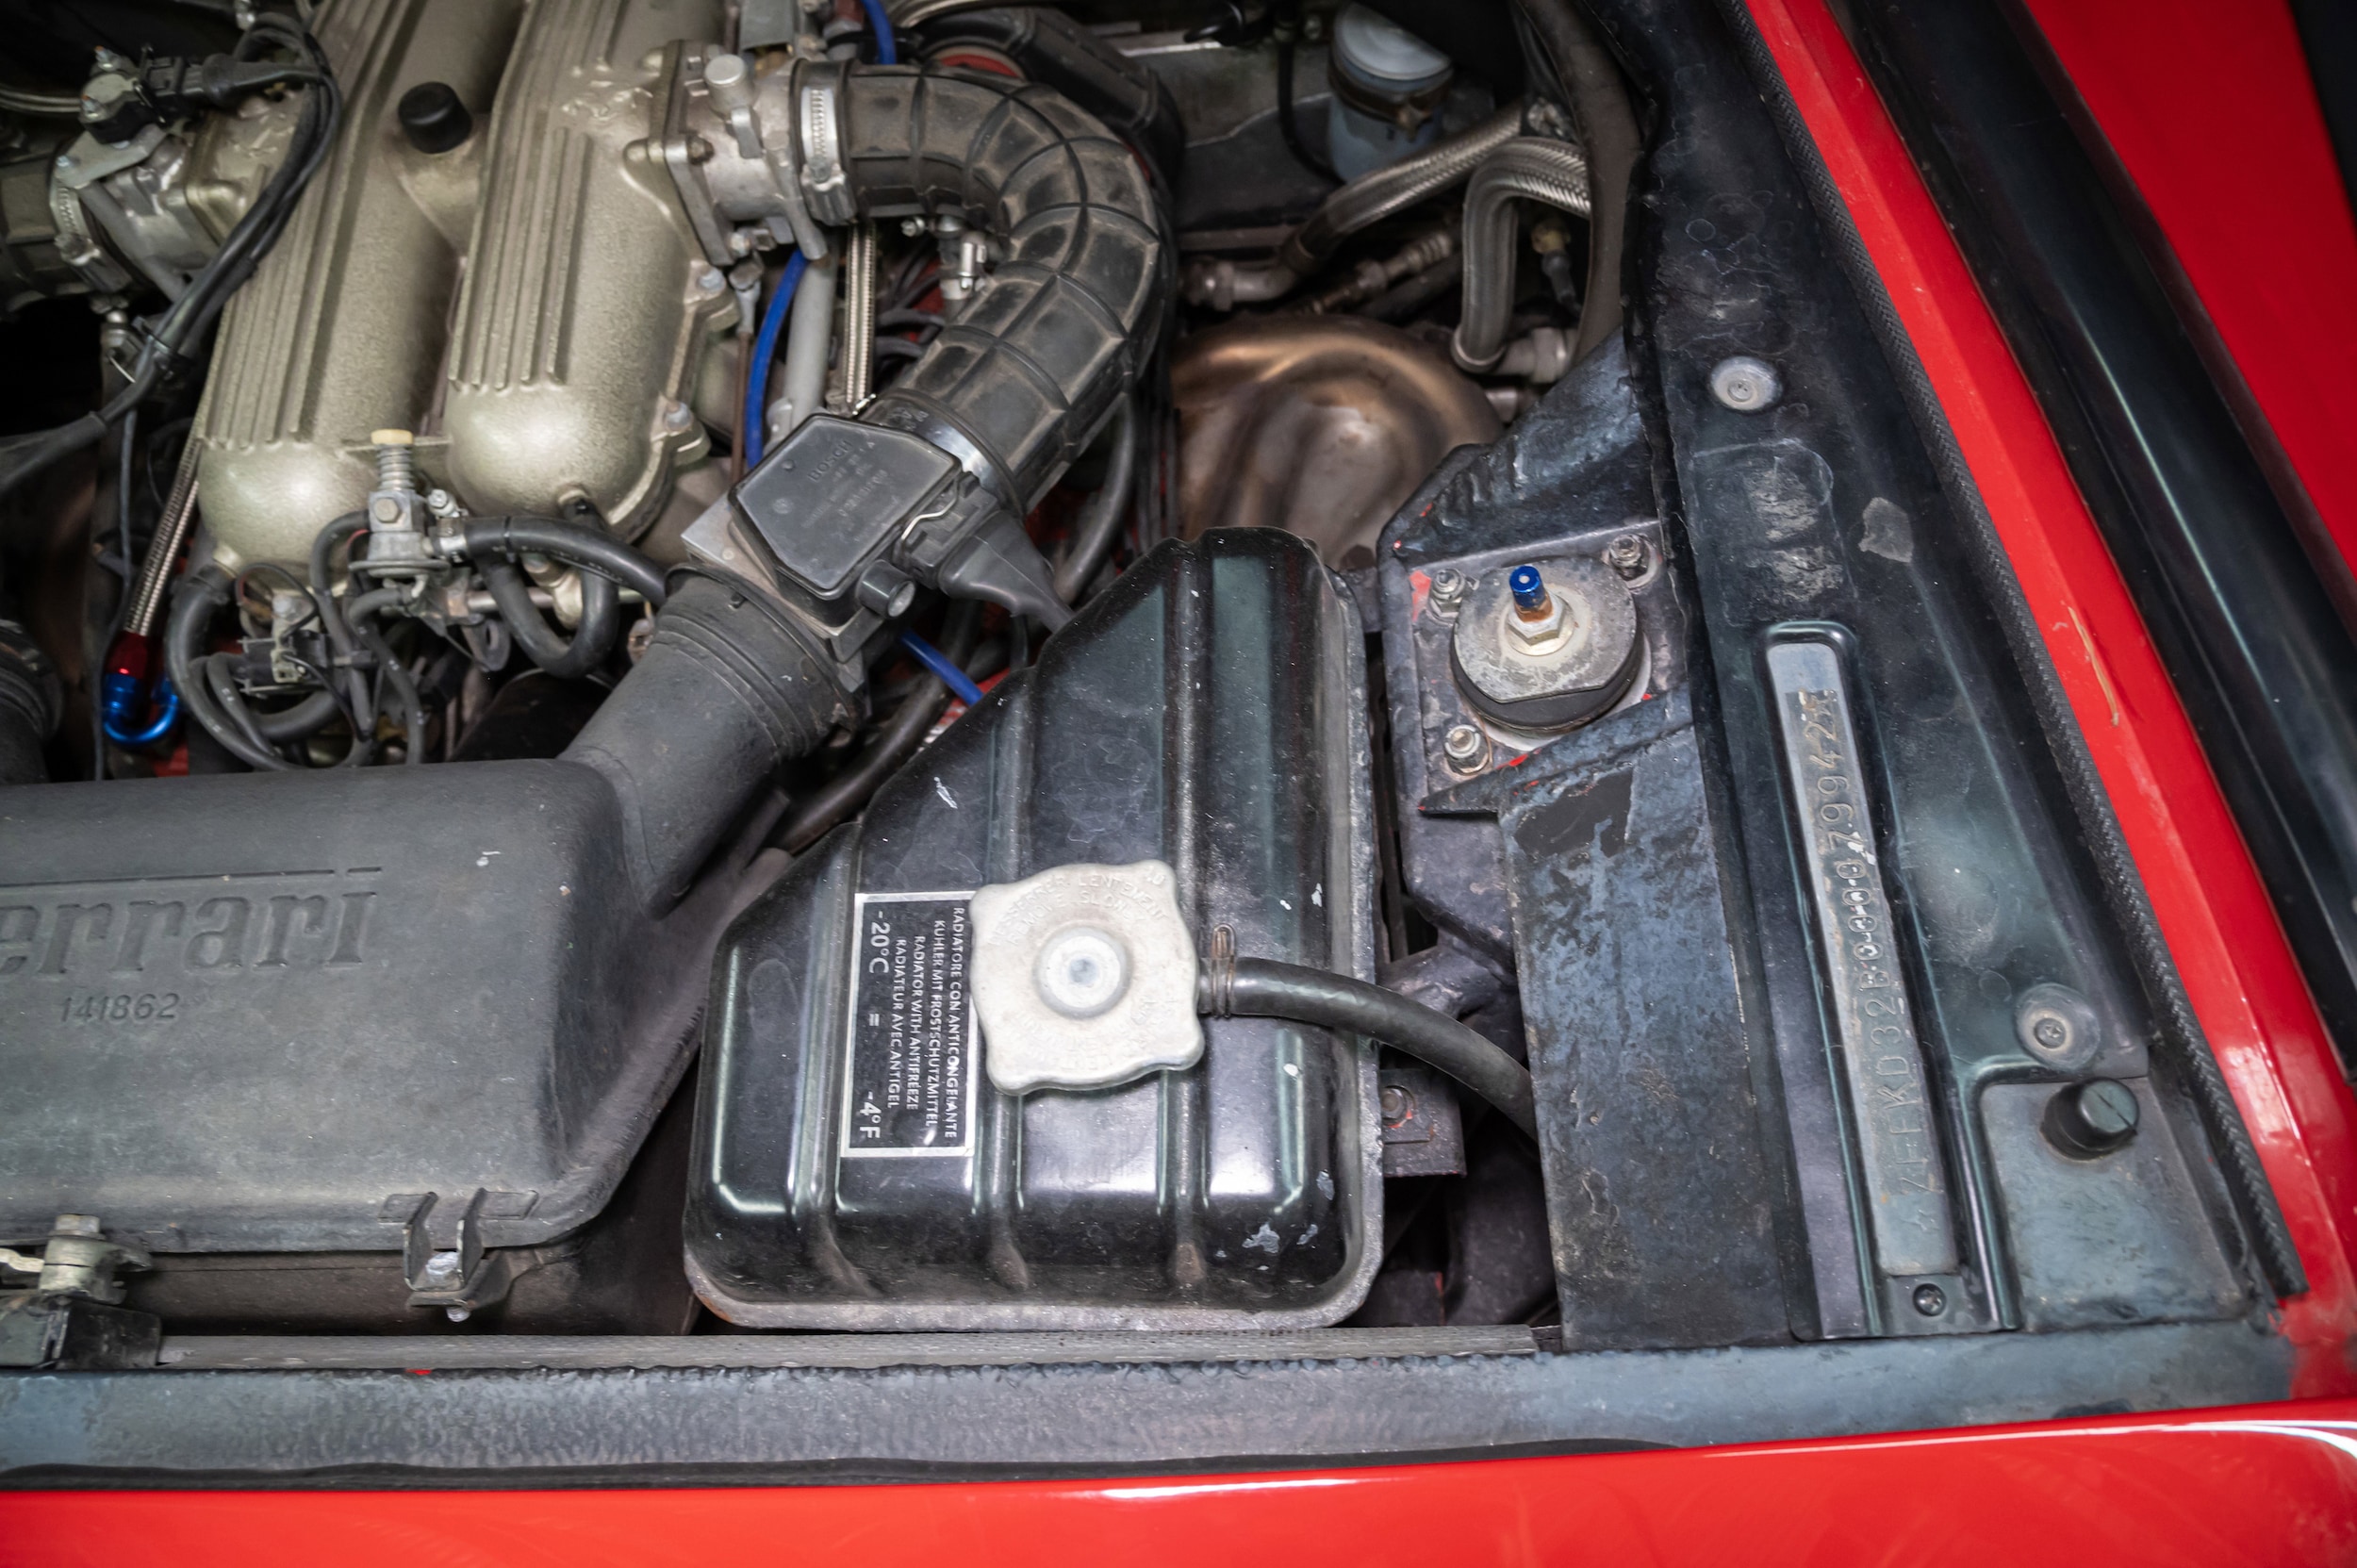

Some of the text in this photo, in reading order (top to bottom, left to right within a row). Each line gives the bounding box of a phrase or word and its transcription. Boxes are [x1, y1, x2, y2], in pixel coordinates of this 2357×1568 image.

[807, 439, 852, 482] BOSCH
[0, 867, 381, 976] errari
[1078, 874, 1168, 921] LENTEMENT
[59, 992, 181, 1022] 141862
[887, 939, 907, 1109] RADIATEUR AVEC ANTIGEL
[906, 935, 926, 1110] RADIATOR WITH ANTIFREEZE
[926, 920, 946, 1127] KUHLER MIT FROSTSCHUTZMITTEL
[945, 907, 964, 1138] RADIATORE CON ANTICONGELANTE
